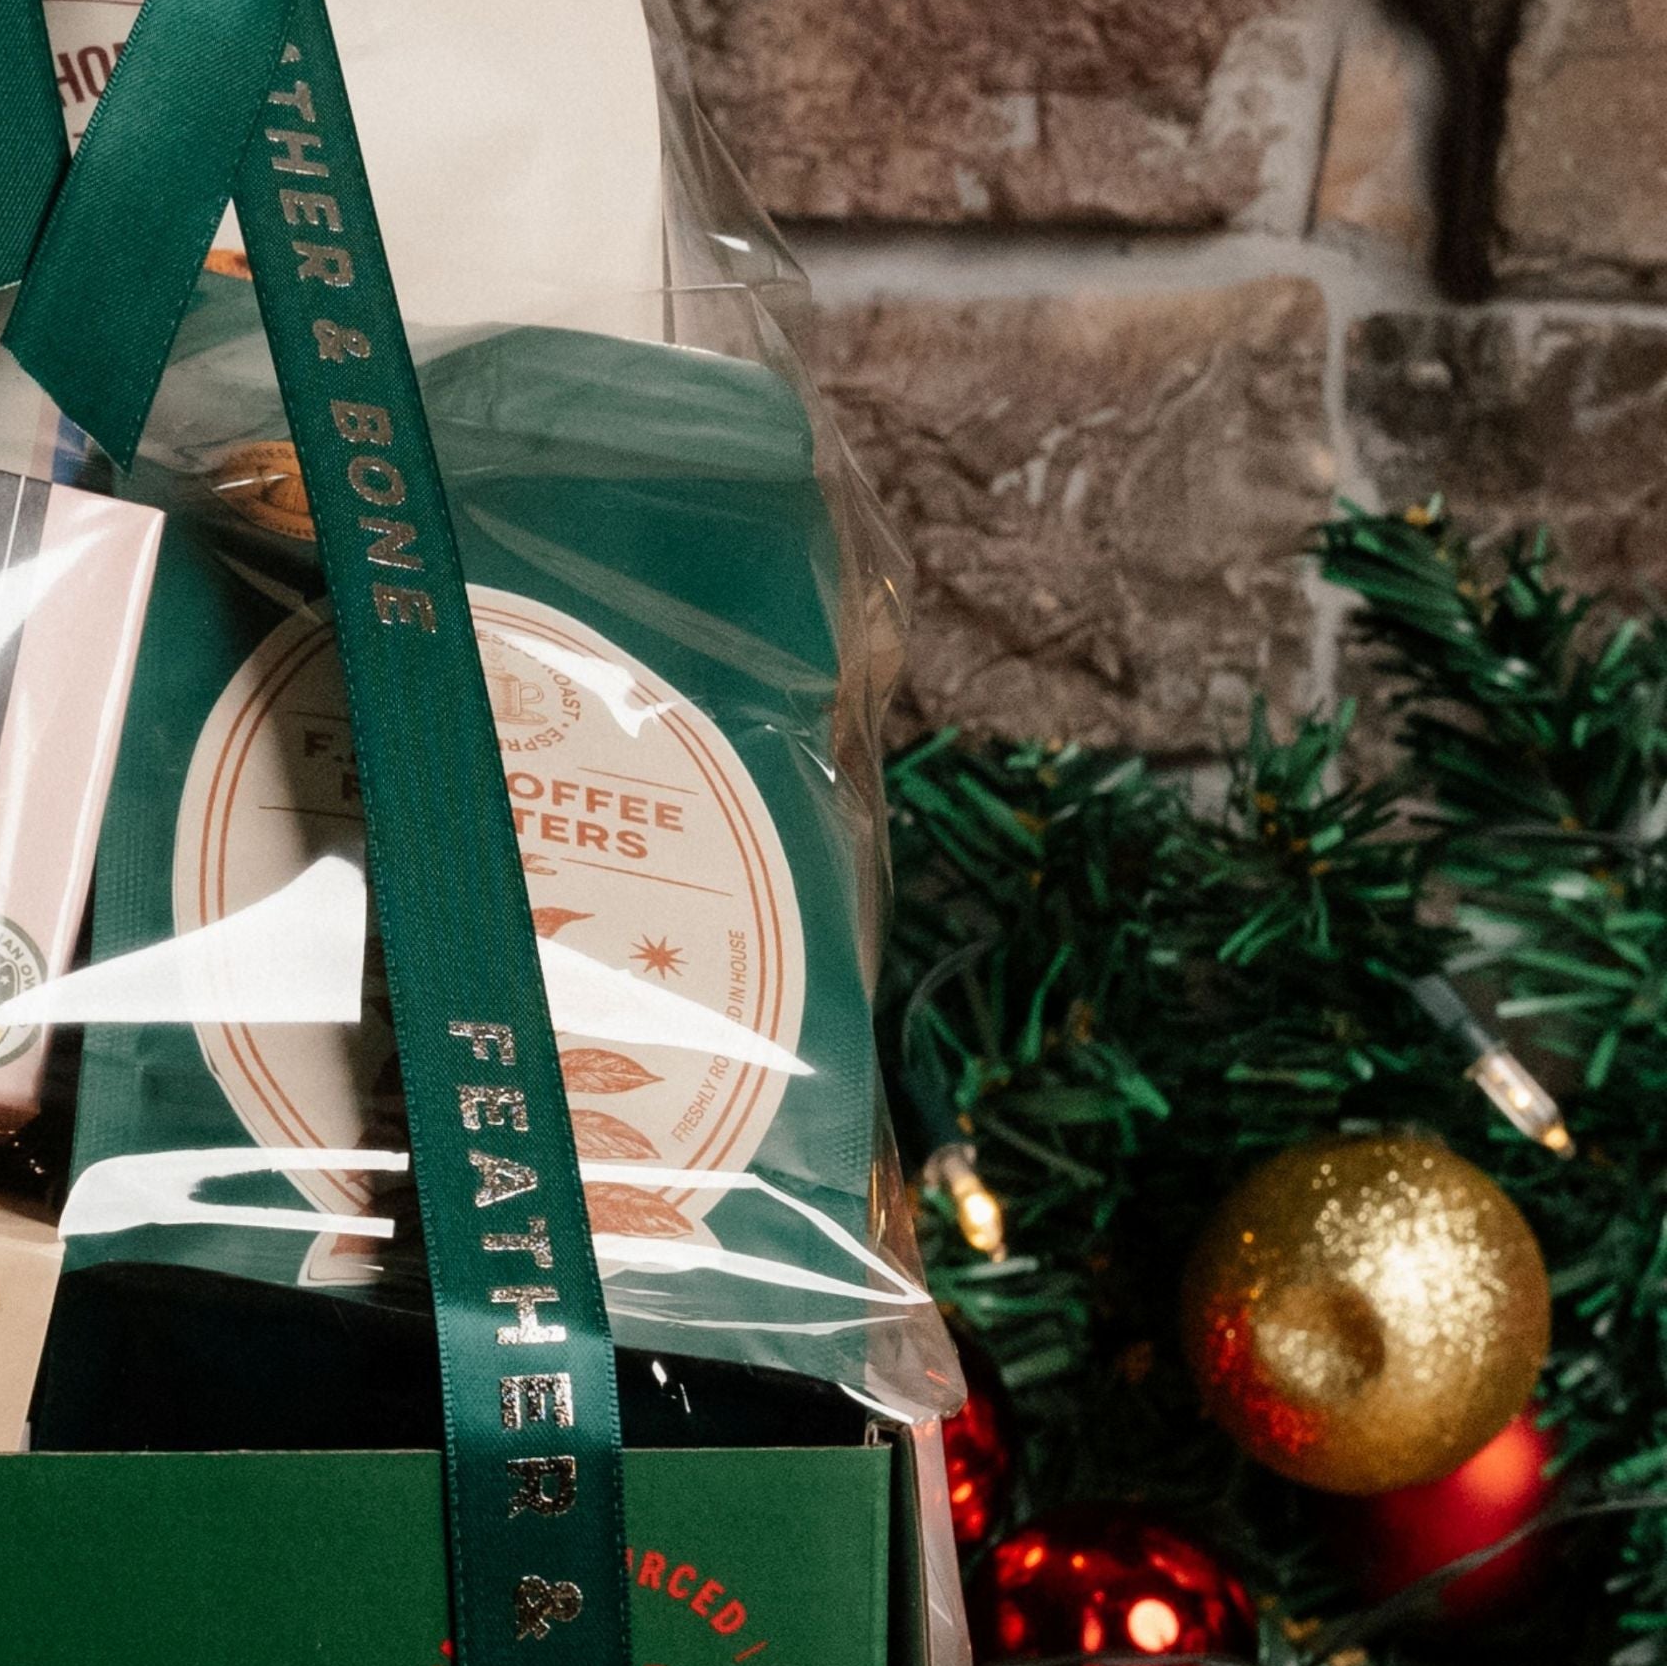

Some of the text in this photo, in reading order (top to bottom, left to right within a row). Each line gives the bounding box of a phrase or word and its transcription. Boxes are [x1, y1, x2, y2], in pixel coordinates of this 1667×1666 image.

[55, 41, 126, 109] HO
[266, 44, 437, 636] THER & BONE
[507, 769, 685, 834] OFFEE
[728, 928, 748, 983] HOUSE
[727, 987, 746, 1006] IN
[670, 1084, 717, 1143] FRESHLY
[447, 1018, 579, 1520] FEATHER
[514, 1574, 584, 1641] &
